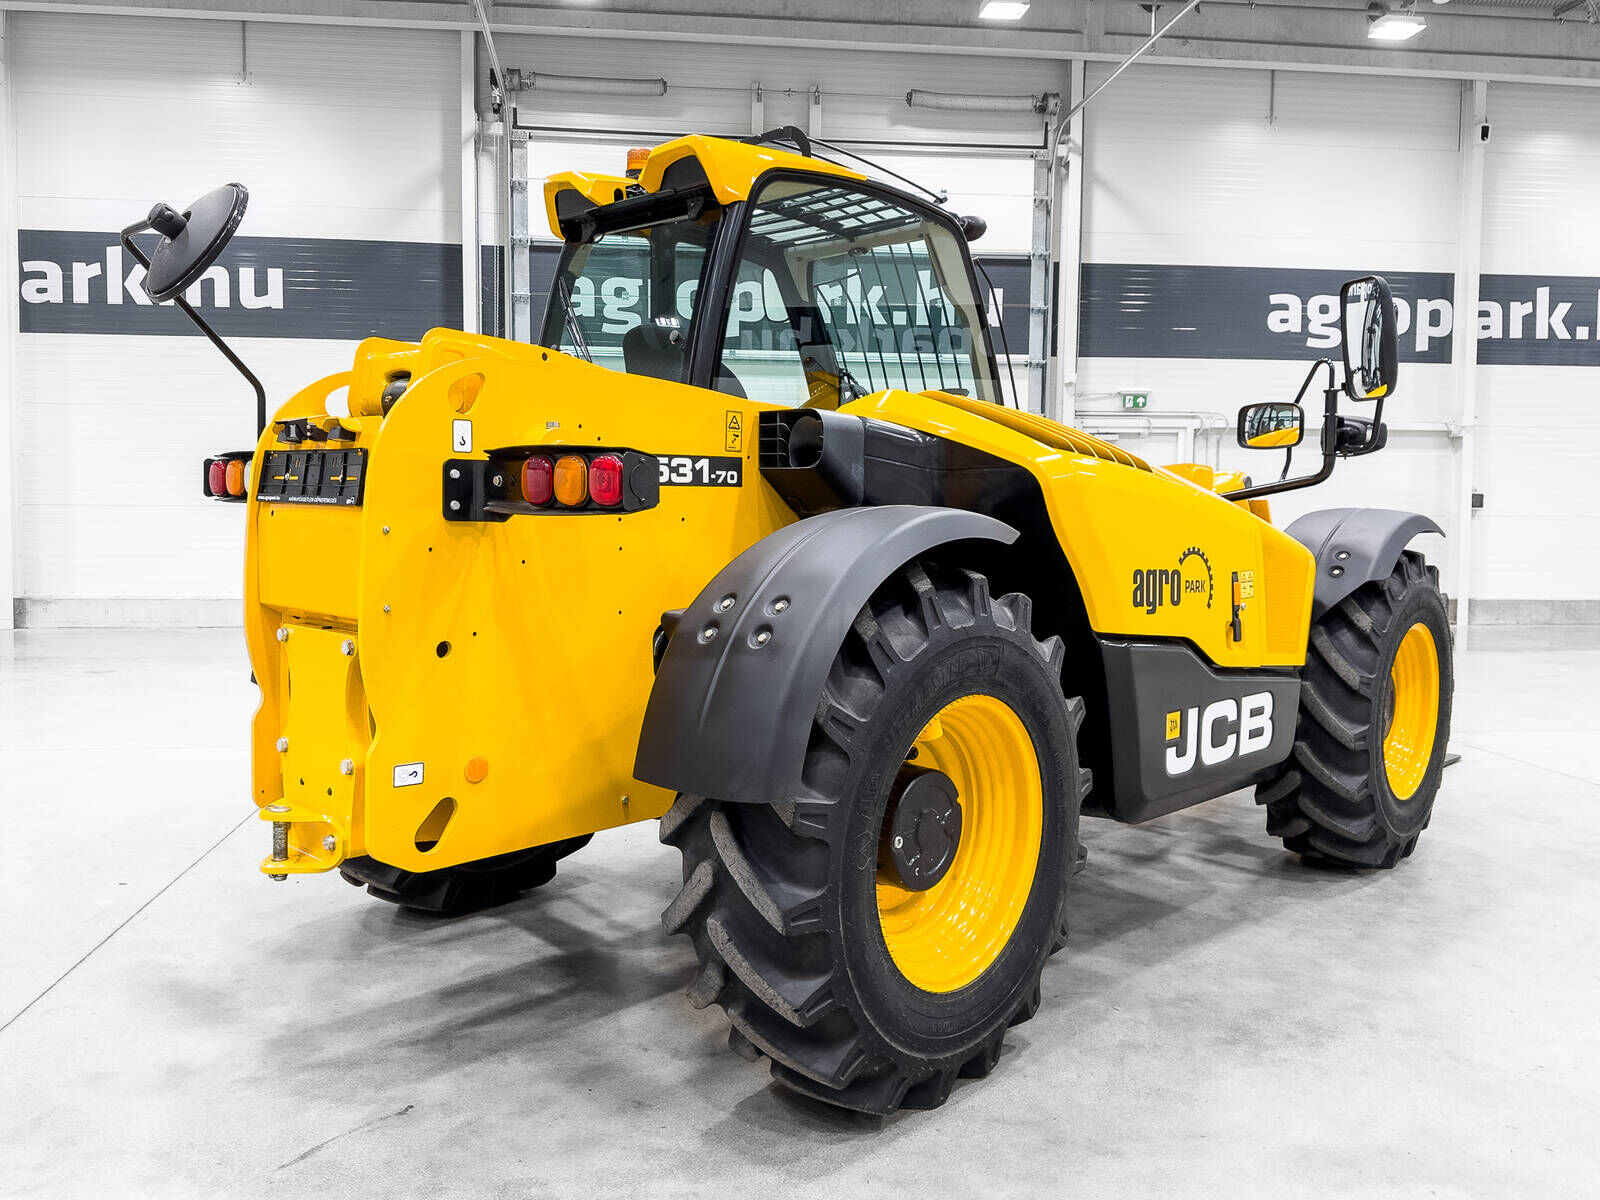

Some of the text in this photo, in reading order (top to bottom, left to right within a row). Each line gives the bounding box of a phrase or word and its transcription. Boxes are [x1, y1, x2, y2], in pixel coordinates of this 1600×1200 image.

[1133, 569, 1206, 614] agro PARK
[1166, 691, 1273, 775] JCB
